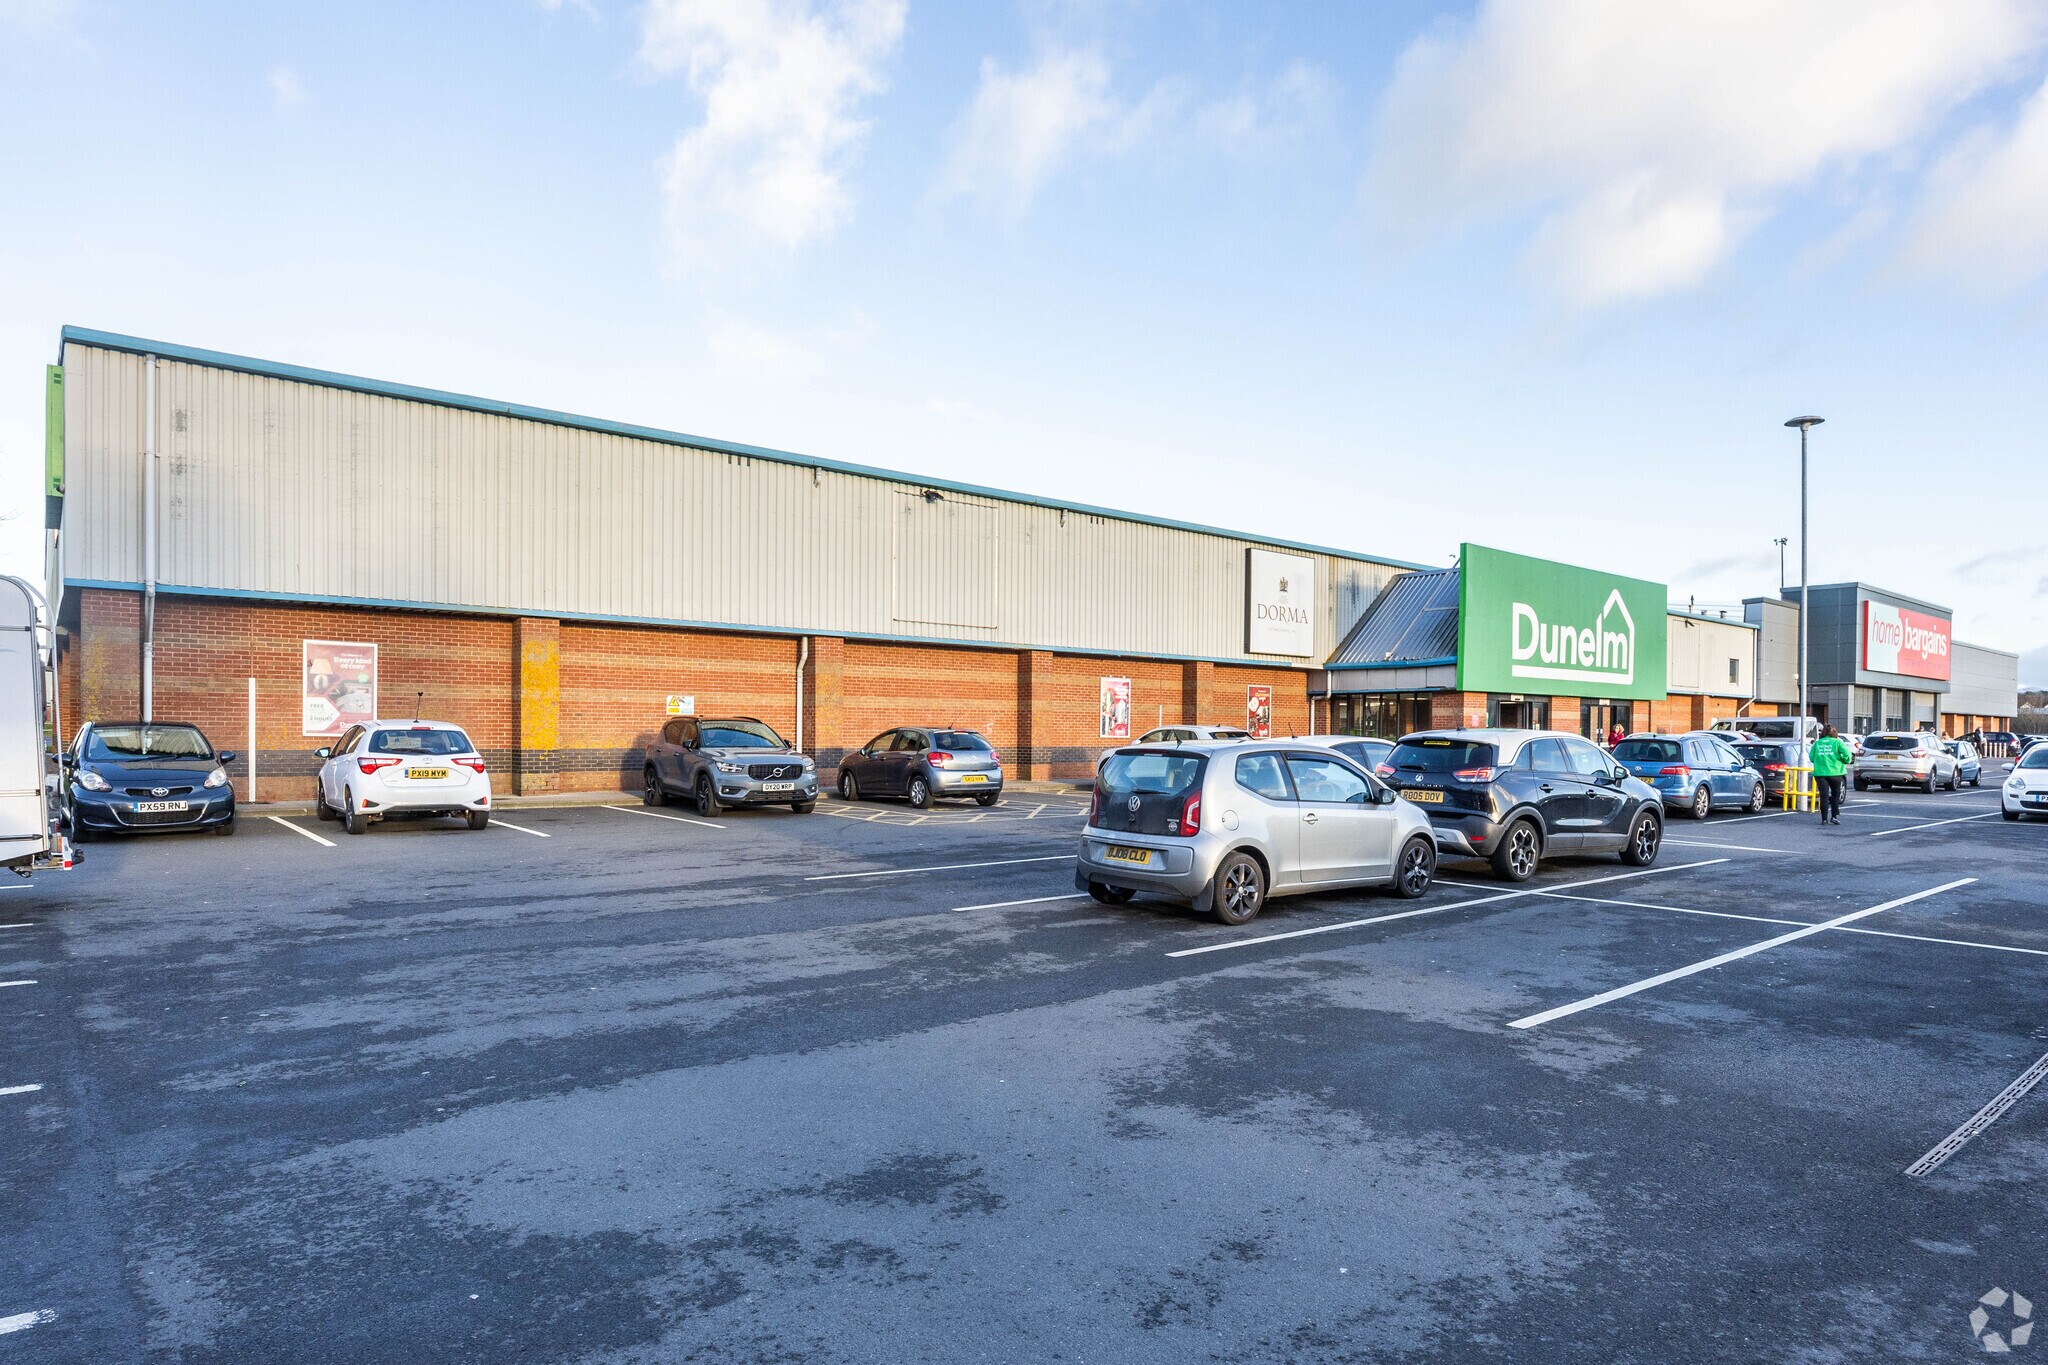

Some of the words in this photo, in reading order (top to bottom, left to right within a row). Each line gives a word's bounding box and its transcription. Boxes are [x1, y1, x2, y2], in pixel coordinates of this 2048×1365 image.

[1257, 603, 1308, 624] DORMA
[1512, 602, 1629, 670] Dunelm
[1872, 612, 1901, 647] home
[1904, 617, 1947, 660] bargains
[334, 656, 354, 664] Every
[140, 802, 166, 811] PX59
[168, 802, 187, 810] RNJ
